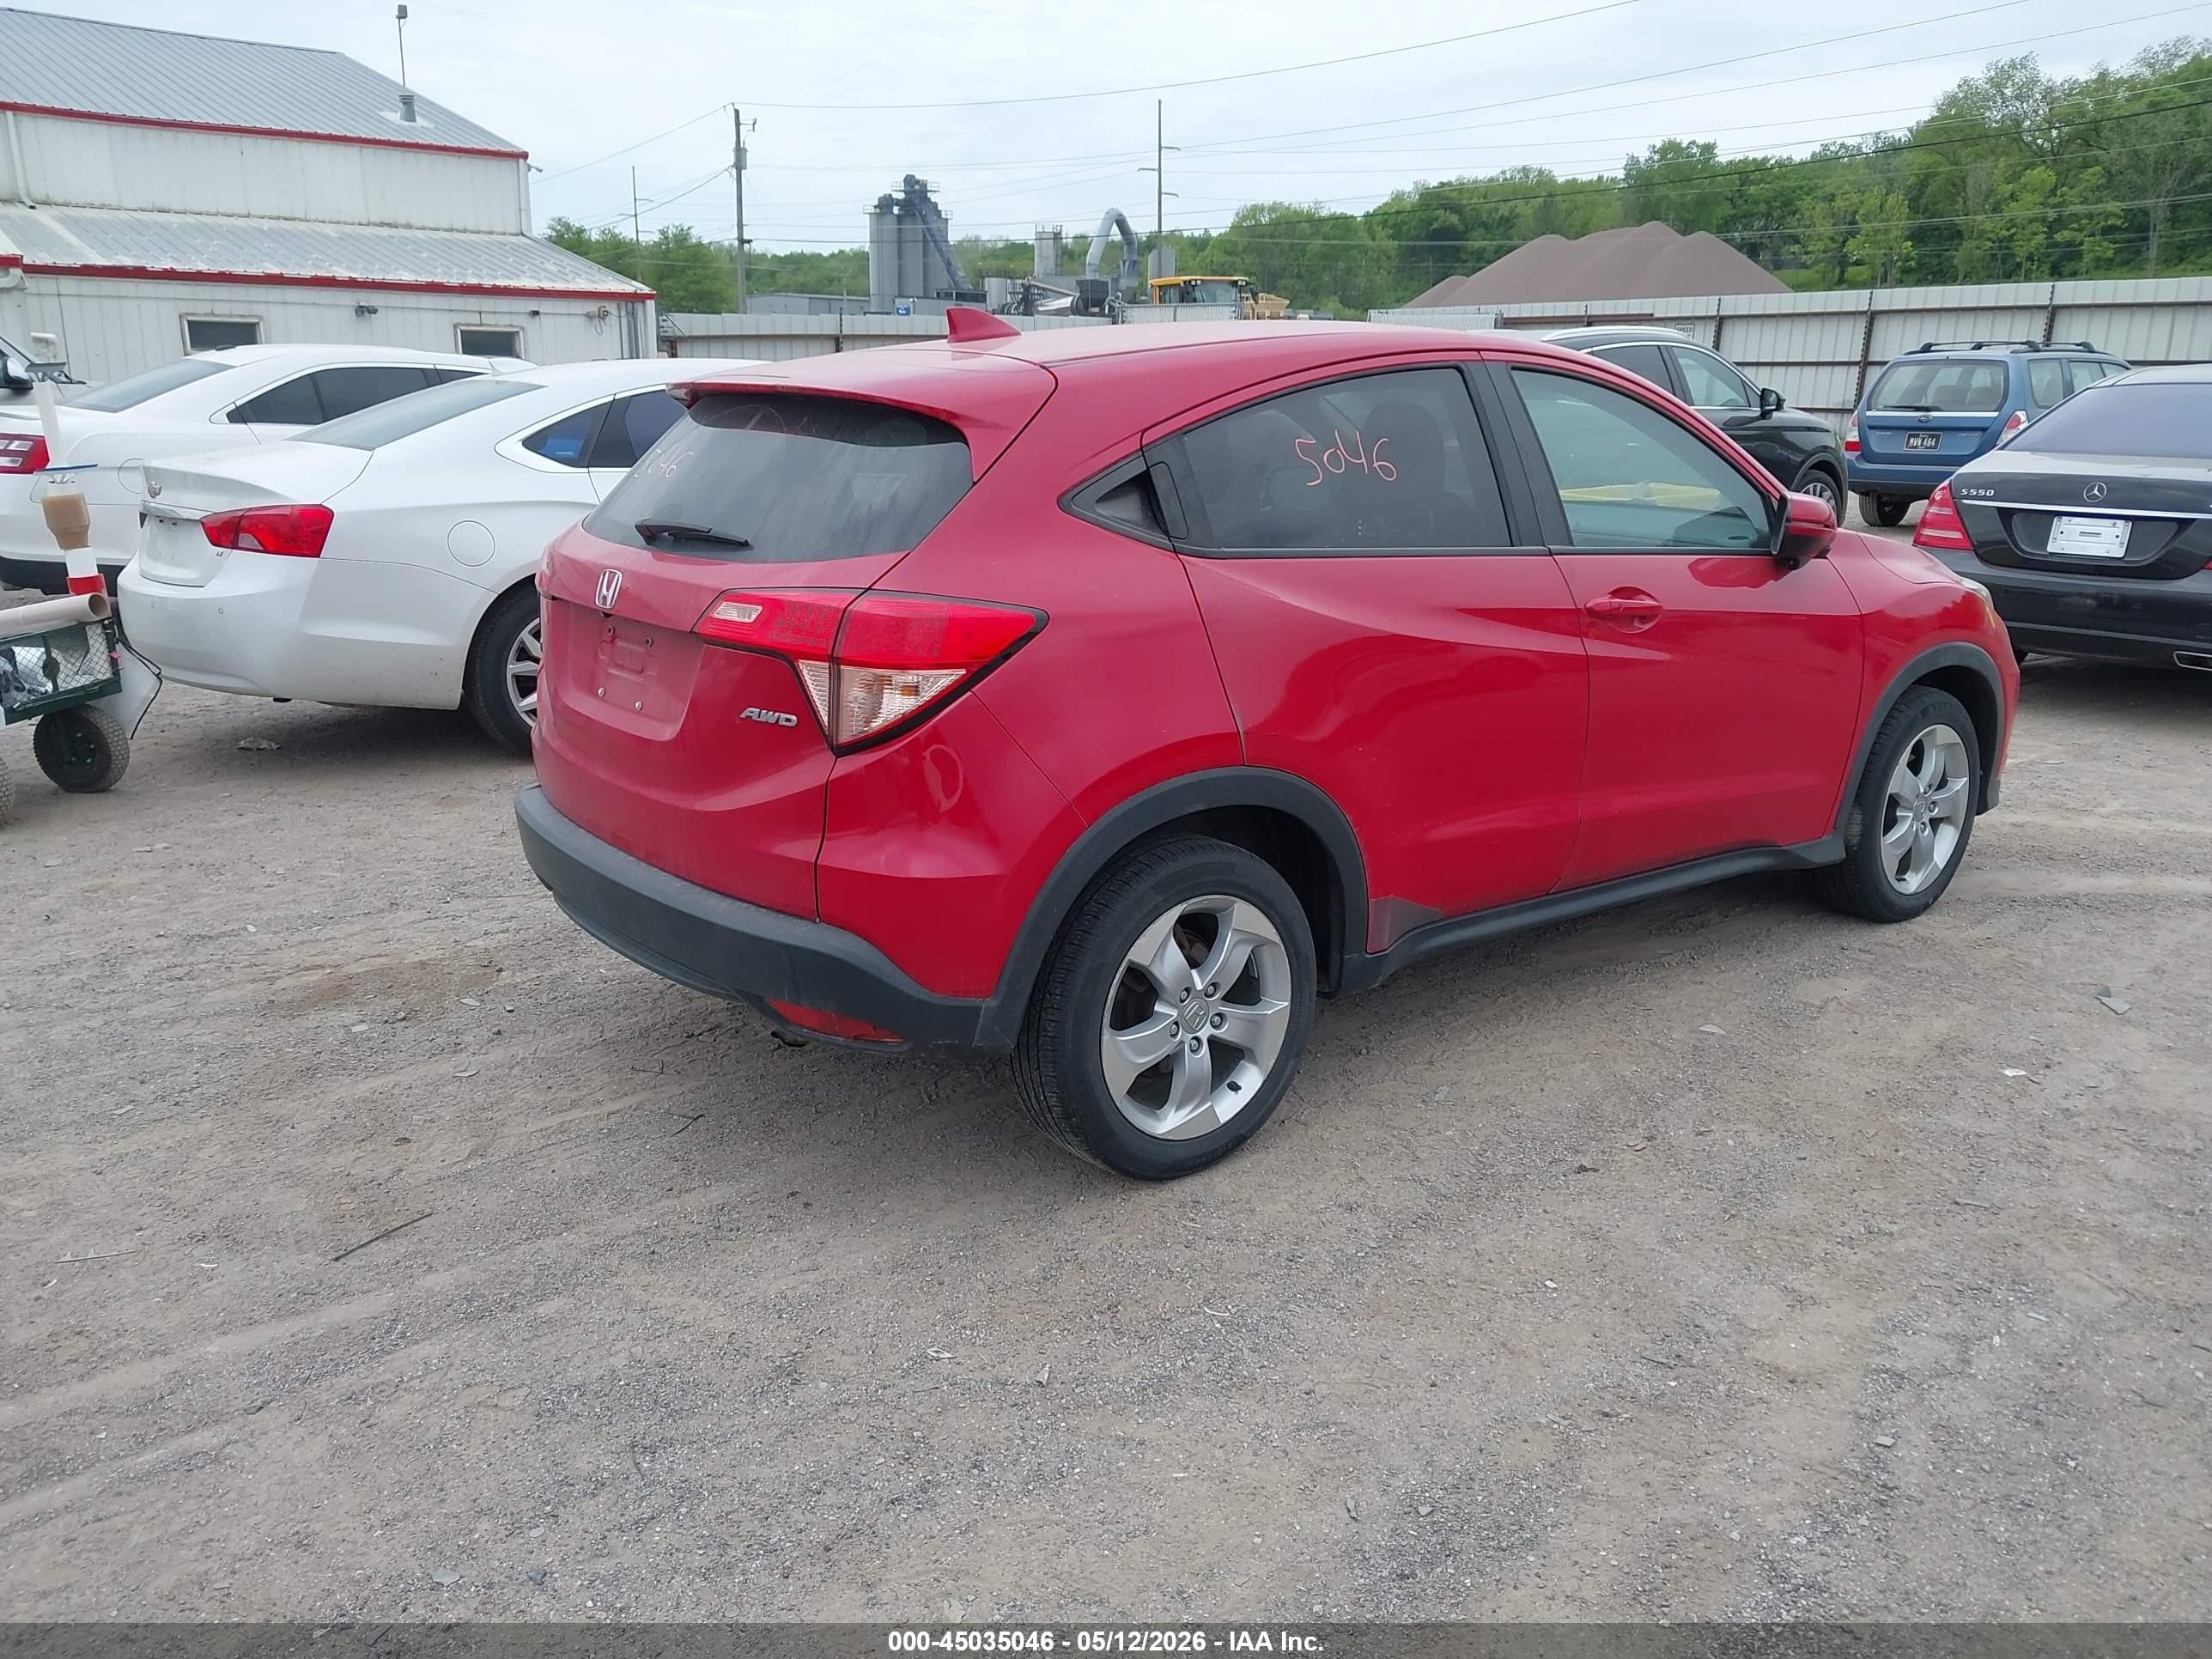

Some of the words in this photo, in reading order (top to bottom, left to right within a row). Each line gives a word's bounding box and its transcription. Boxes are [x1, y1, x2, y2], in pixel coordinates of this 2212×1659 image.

[1295, 429, 1397, 486] 5046
[1960, 488, 1995, 496] S550
[739, 708, 798, 727] AWD
